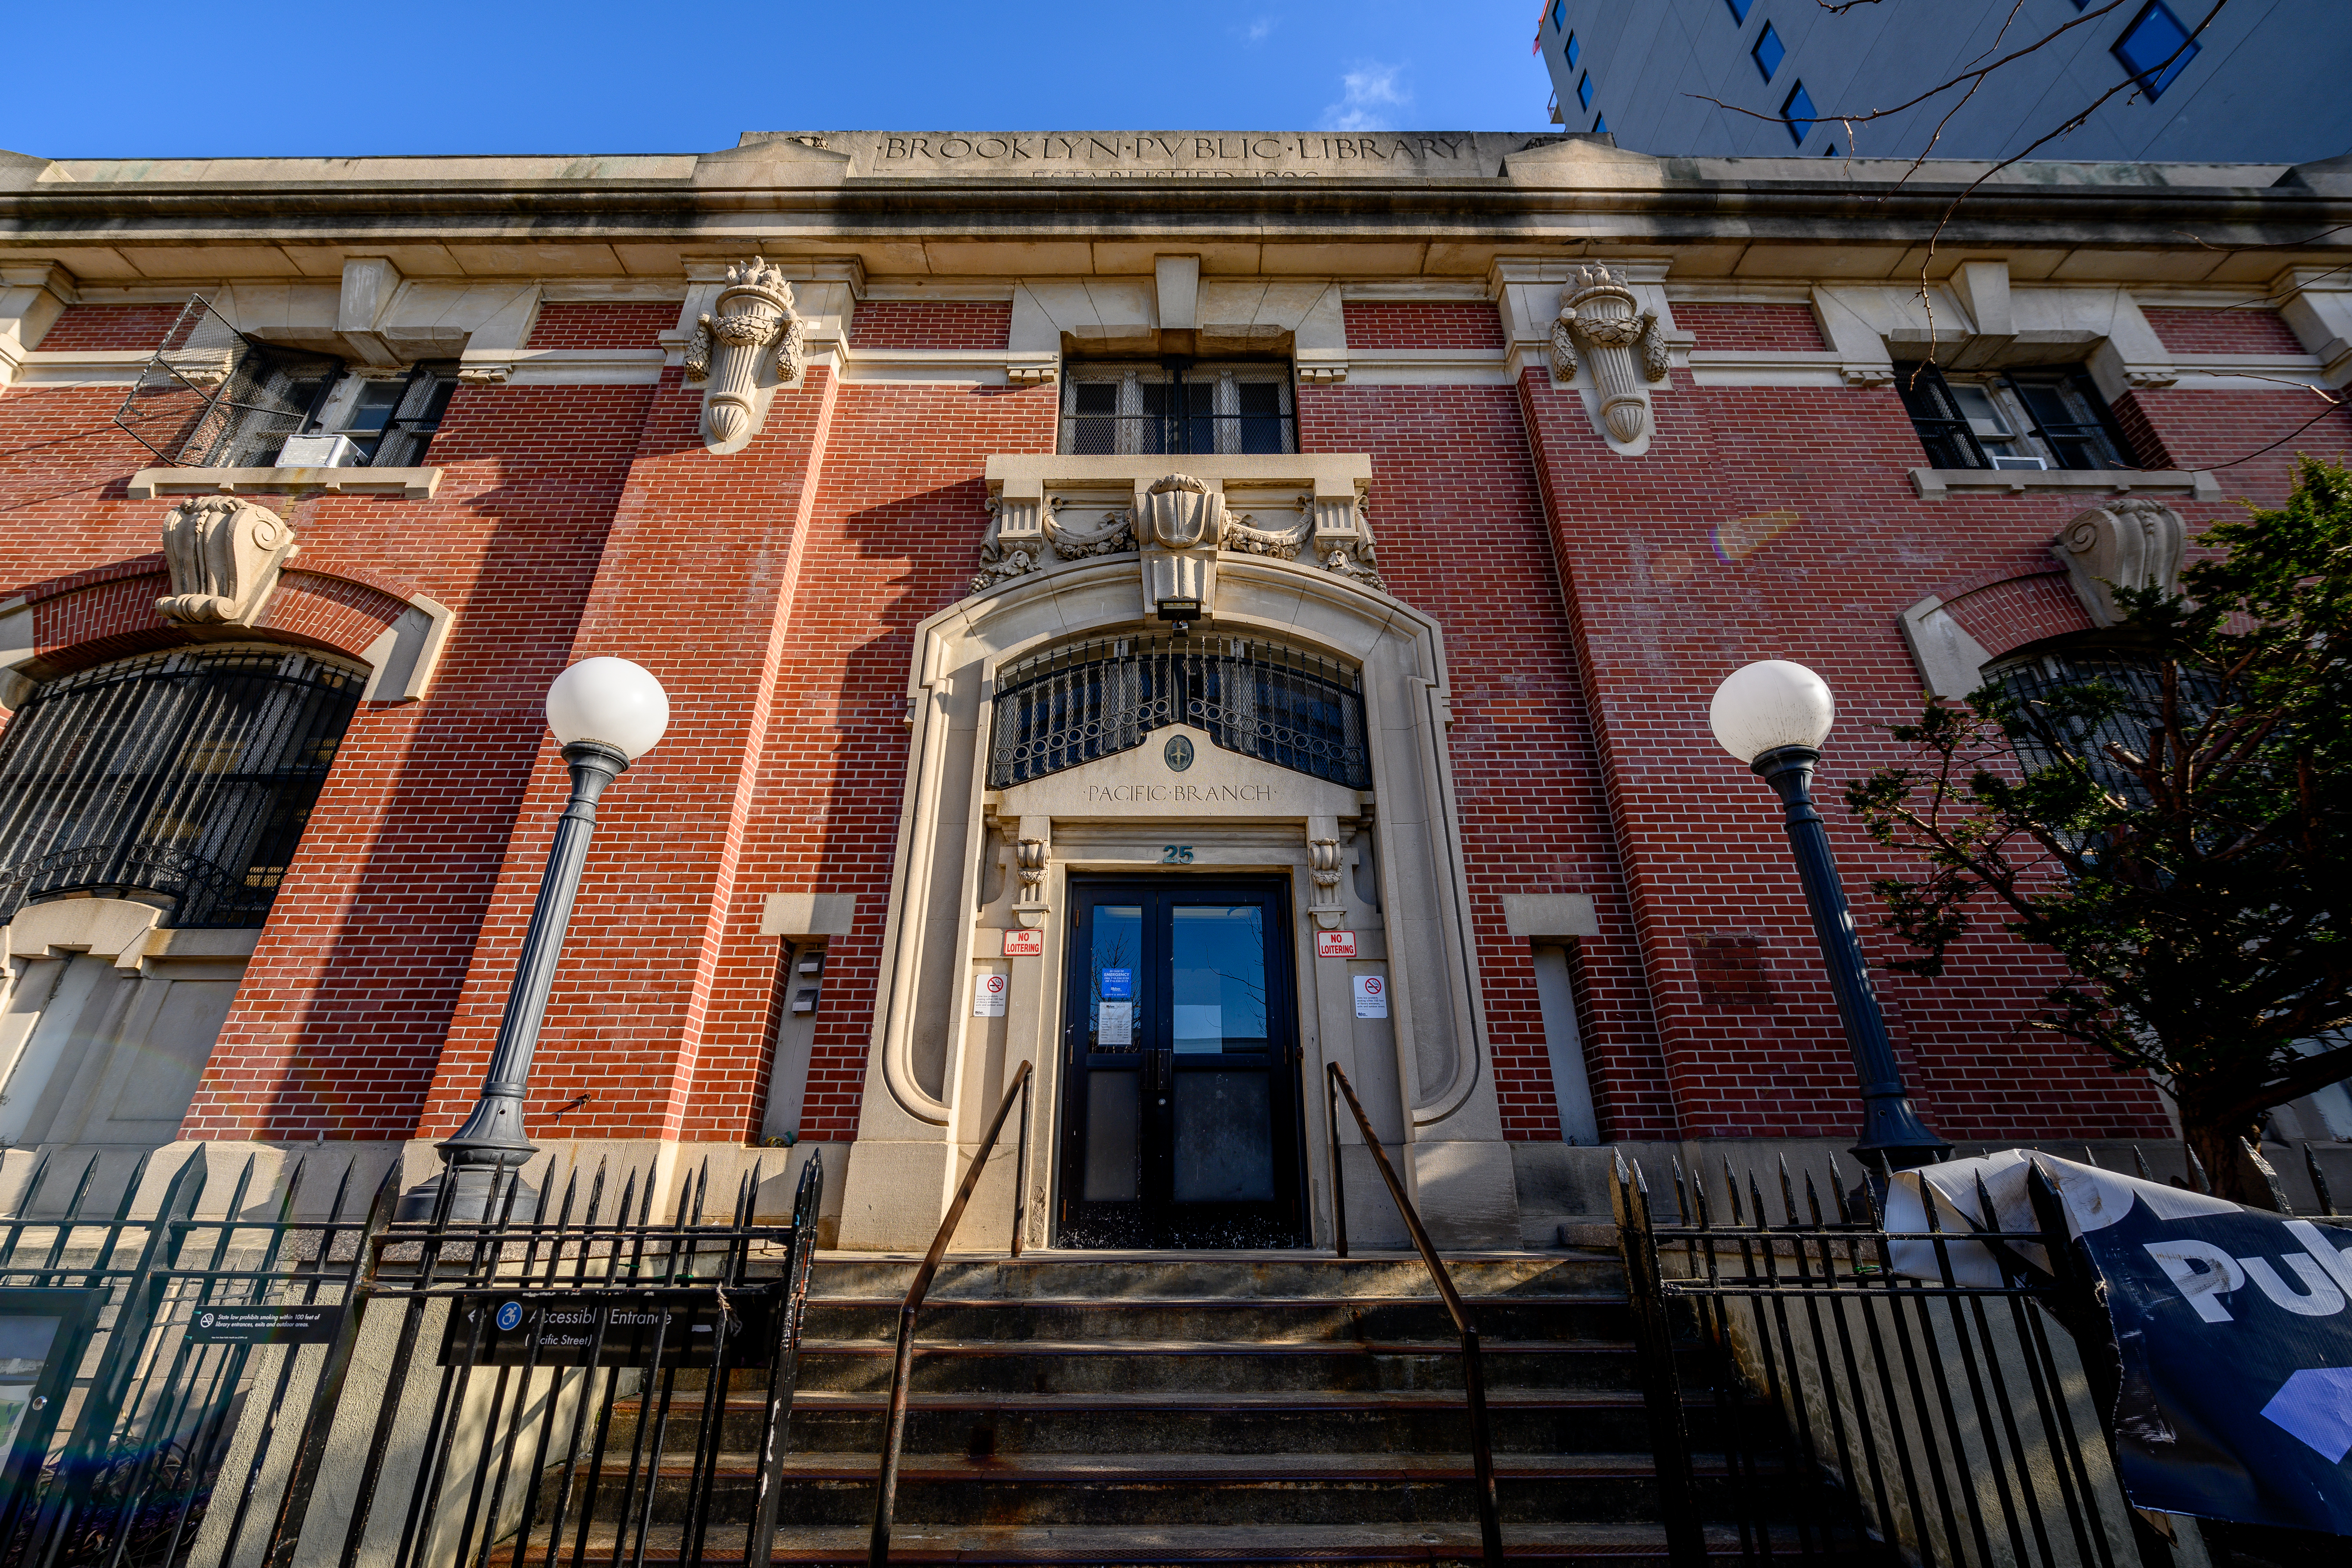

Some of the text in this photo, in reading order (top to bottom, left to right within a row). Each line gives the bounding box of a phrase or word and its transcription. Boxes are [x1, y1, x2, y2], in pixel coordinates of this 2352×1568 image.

[885, 137, 1465, 159] BROOKLYN PVBLIC LIBRARY
[1088, 785, 1271, 801] PACIFIC BRANCH
[1164, 845, 1194, 864] 25
[1018, 932, 1029, 941] NO
[1330, 934, 1342, 943] NO
[1007, 943, 1039, 952] LOITERING
[1321, 945, 1354, 954] LOITERING
[528, 1307, 597, 1323] Acessibl
[525, 1334, 592, 1347] (cific Street)
